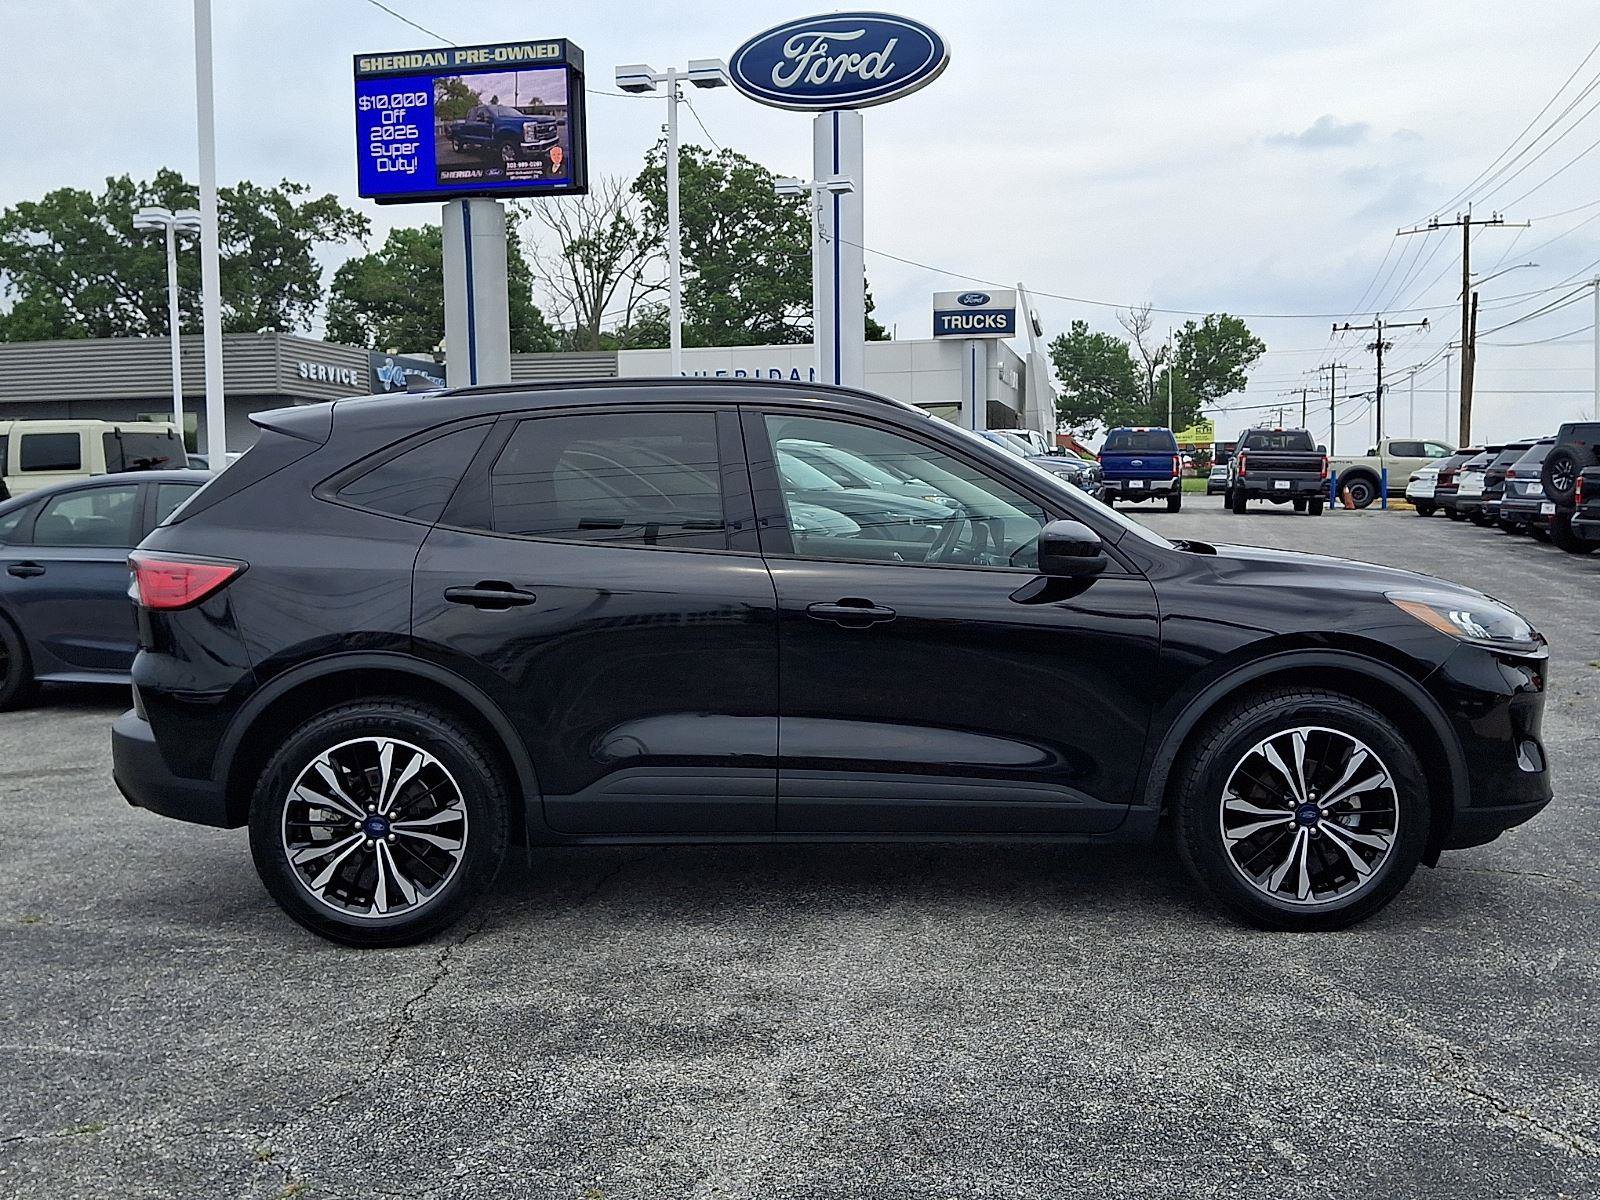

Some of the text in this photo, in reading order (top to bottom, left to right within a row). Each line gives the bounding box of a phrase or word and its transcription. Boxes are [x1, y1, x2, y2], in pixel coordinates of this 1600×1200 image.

[360, 43, 560, 72] SHERIDAN PRE-OWNED
[771, 29, 898, 88] Ford
[358, 92, 428, 111] $10,000
[381, 109, 406, 124] Off
[370, 124, 419, 141] 2026
[370, 142, 420, 159] Super
[376, 156, 418, 174] Duty!
[440, 169, 483, 180] SHERIDAN
[941, 314, 1007, 330] TRUCKS
[299, 362, 359, 386] SERVICE
[681, 367, 816, 382] RIDAN
